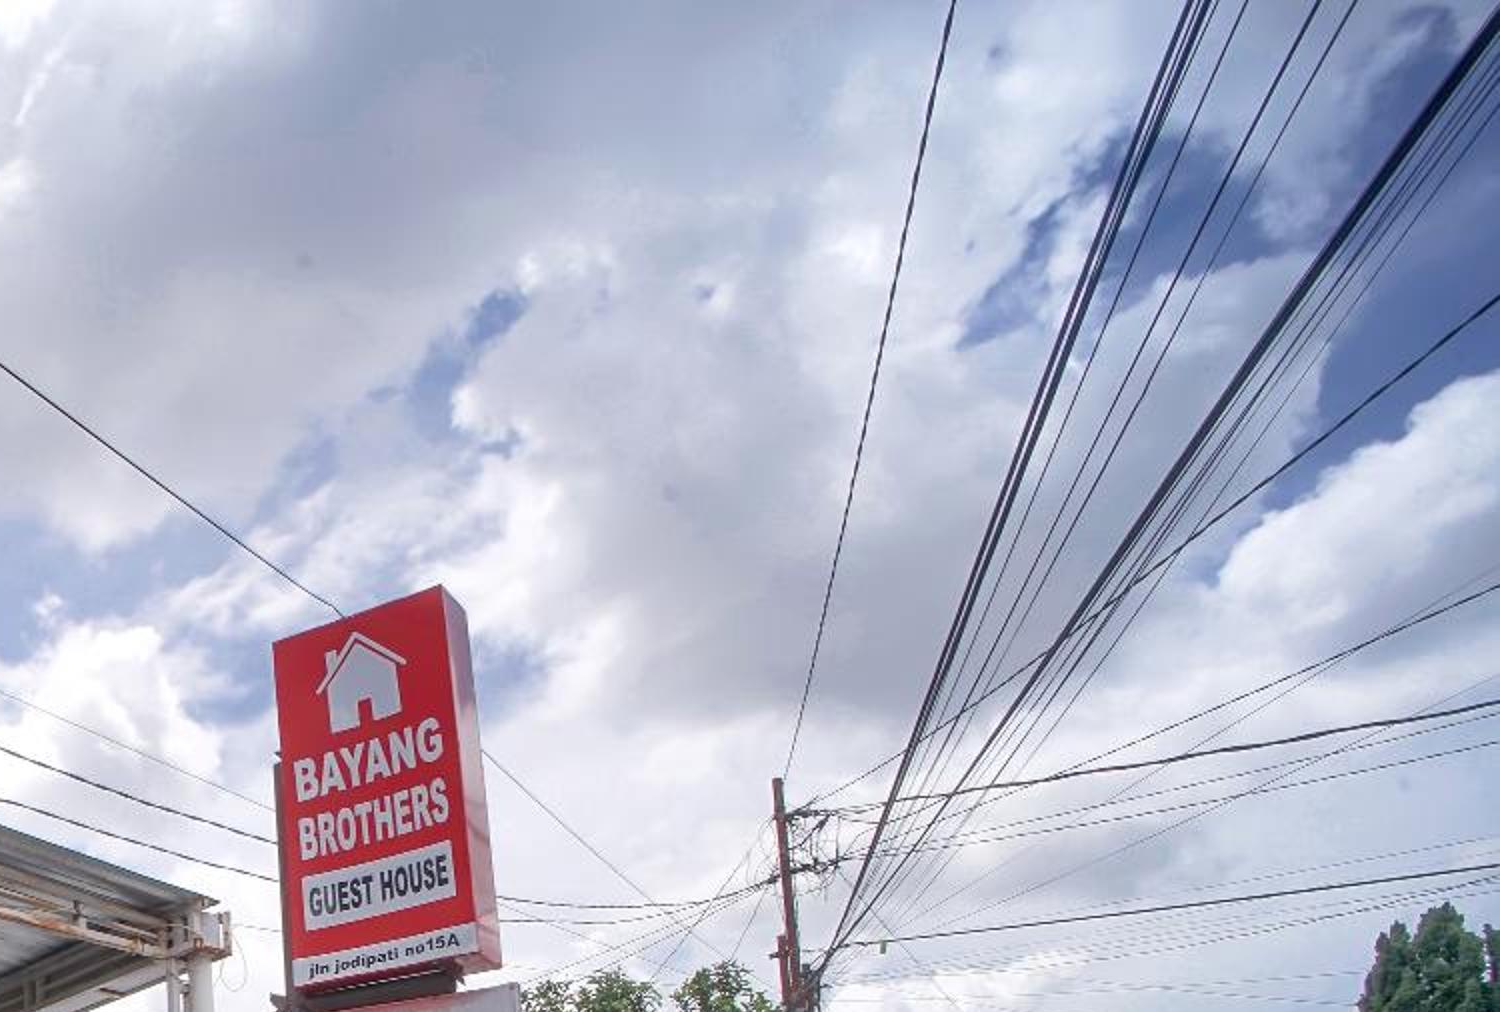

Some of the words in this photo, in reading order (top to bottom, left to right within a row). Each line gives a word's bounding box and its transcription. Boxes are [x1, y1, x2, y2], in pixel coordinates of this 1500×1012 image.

[293, 717, 443, 802] BAYANG
[298, 777, 449, 861] BROTHERS
[309, 875, 373, 916] GUEST
[379, 855, 448, 901] HOUSE
[309, 962, 329, 979] jln
[334, 946, 399, 975] jodipati
